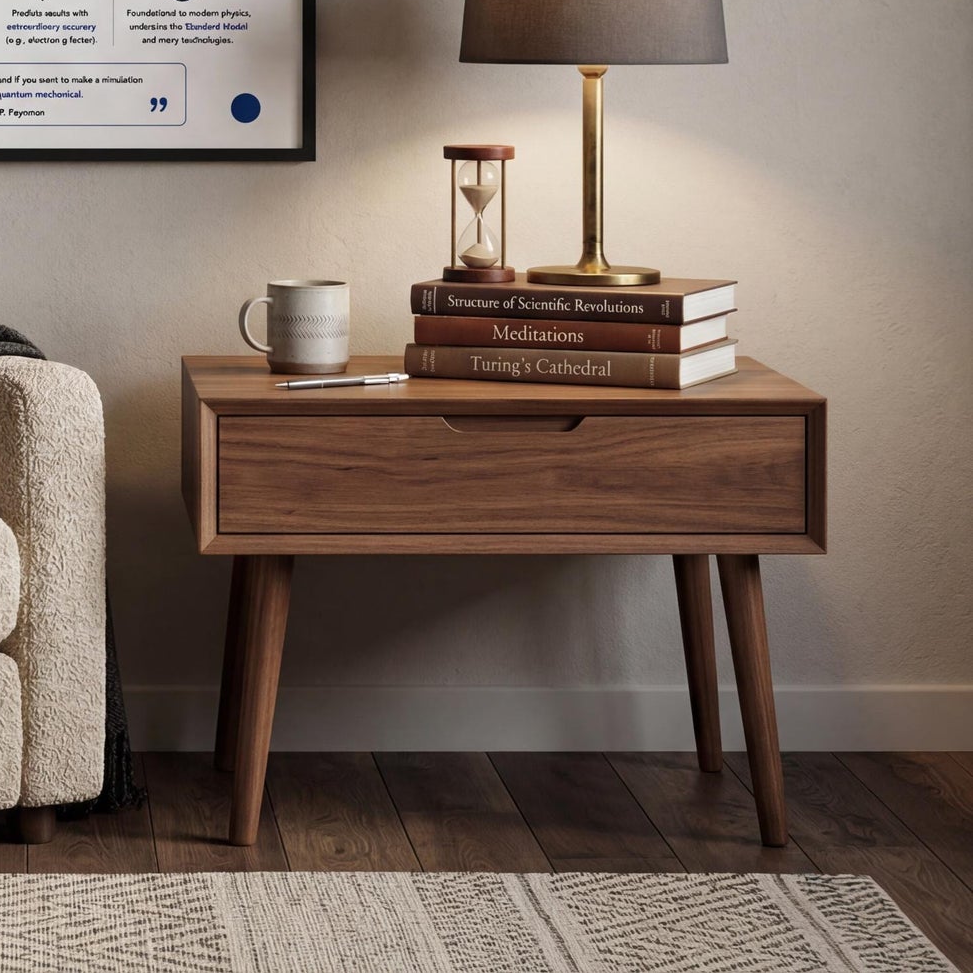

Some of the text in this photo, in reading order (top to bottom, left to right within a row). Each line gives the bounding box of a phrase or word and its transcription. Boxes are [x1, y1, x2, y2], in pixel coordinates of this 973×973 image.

[22, 78, 37, 86] you
[447, 294, 500, 309] Structure
[502, 295, 517, 309] of
[518, 296, 571, 311] Scientific
[574, 298, 644, 314] Revolutions
[492, 324, 584, 343] Meditations
[470, 355, 612, 377] Turing's Cathedral
